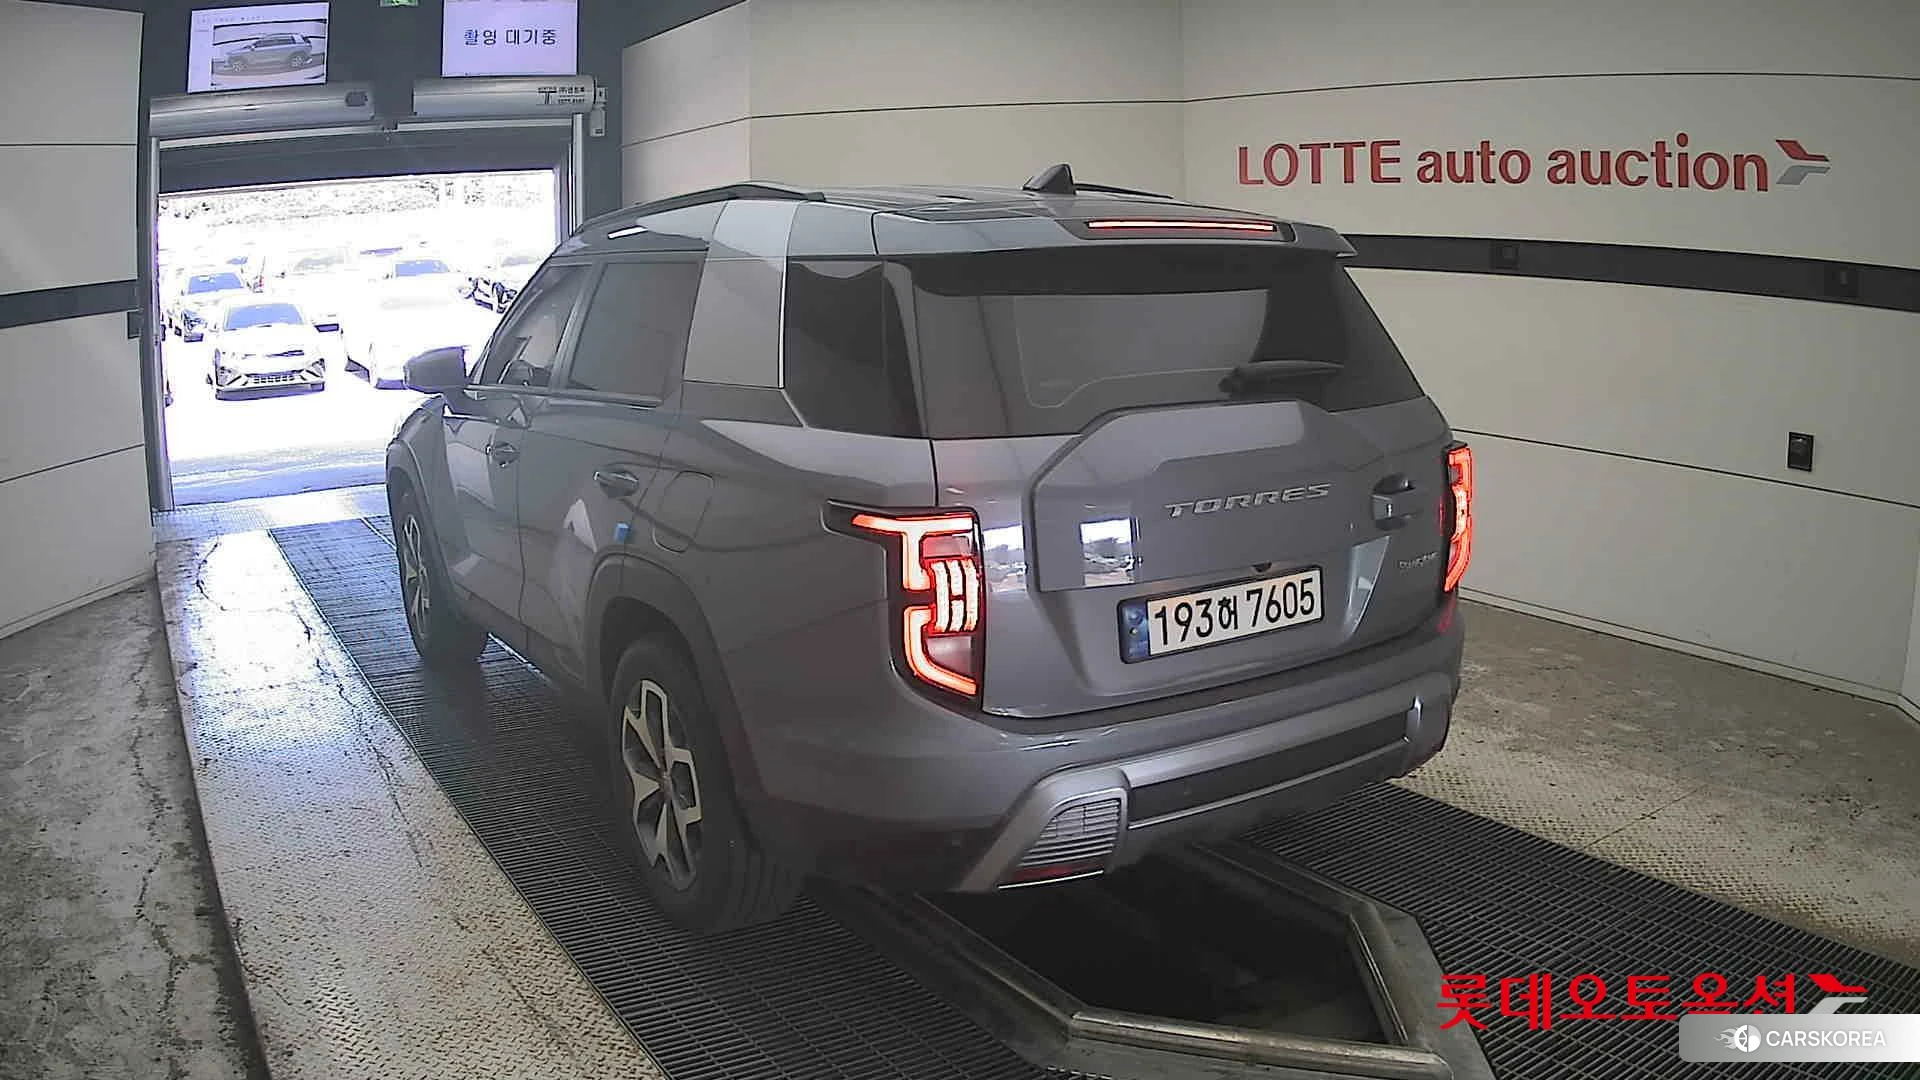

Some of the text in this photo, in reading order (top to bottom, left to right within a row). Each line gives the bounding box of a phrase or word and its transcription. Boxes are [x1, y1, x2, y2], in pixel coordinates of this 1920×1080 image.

[464, 28, 557, 47] 촬영 대기중
[1239, 133, 1769, 192] LOTTE auto auction
[1165, 482, 1333, 519] TORRES
[1154, 578, 1315, 646] 193허 7605
